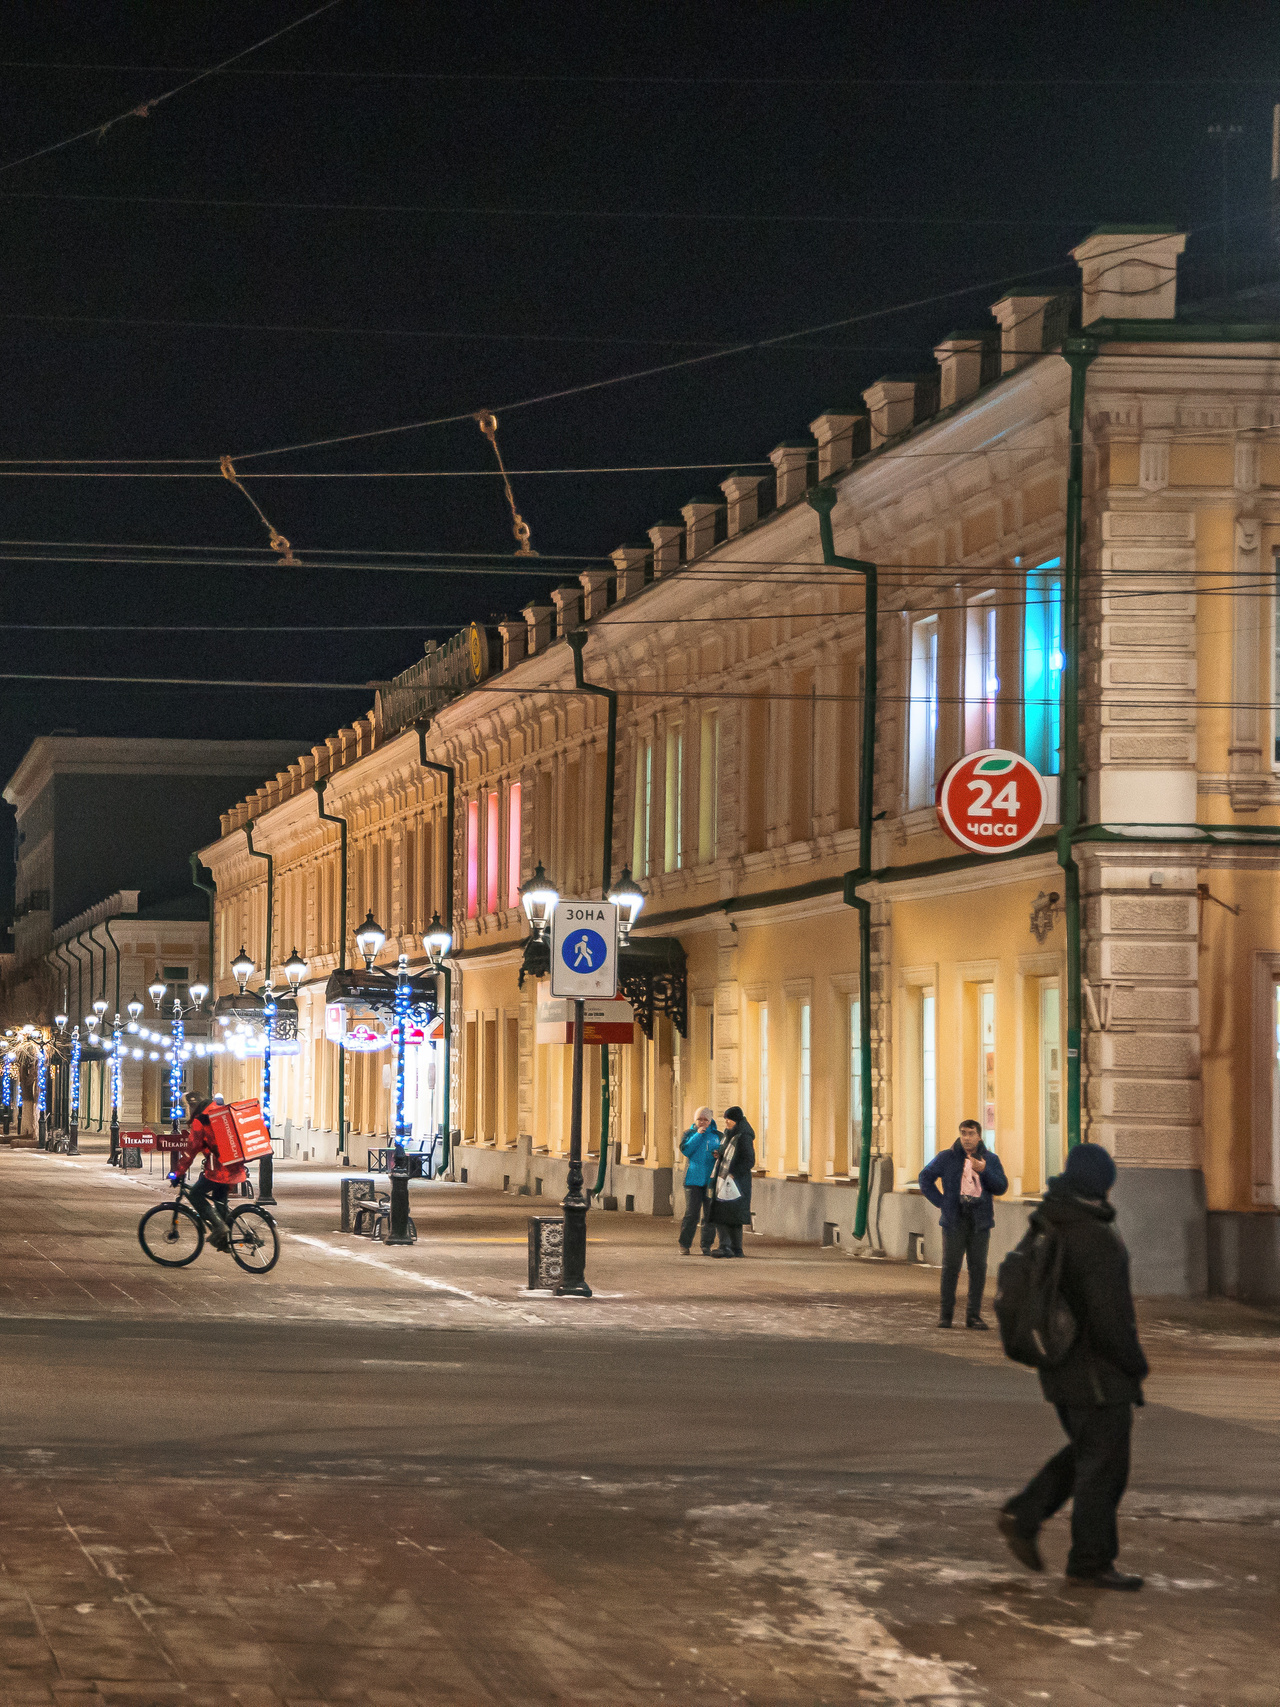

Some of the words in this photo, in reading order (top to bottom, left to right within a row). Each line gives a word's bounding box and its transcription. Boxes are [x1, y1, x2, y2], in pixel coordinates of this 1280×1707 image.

[967, 779, 1021, 817] 24
[967, 822, 1018, 837] часа
[566, 909, 605, 921] ЗОНА
